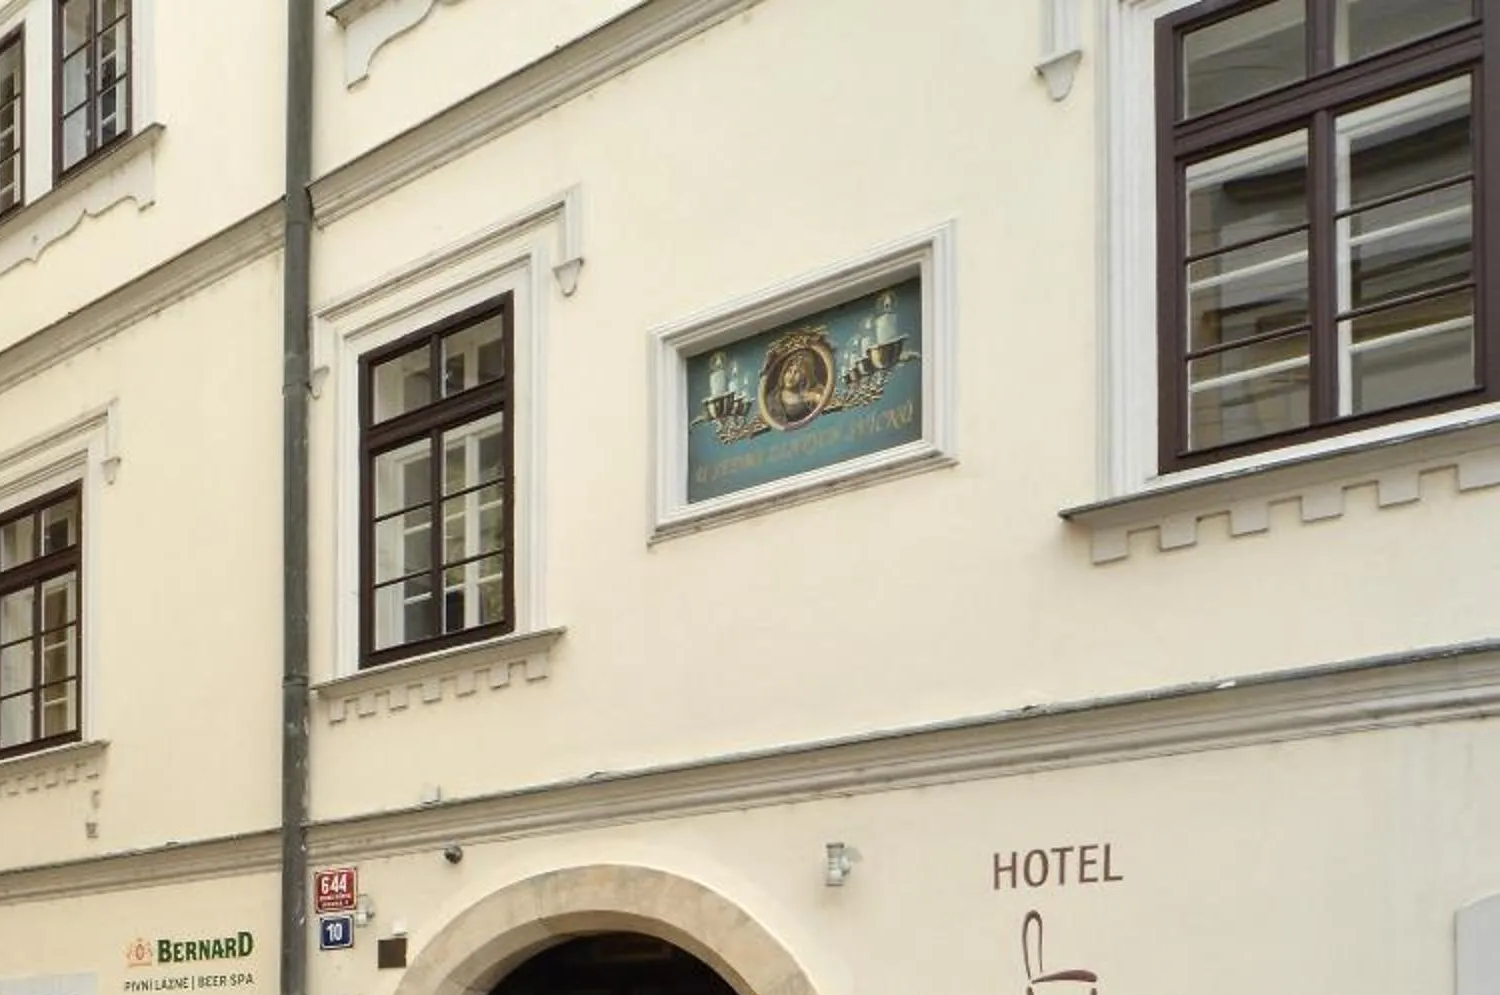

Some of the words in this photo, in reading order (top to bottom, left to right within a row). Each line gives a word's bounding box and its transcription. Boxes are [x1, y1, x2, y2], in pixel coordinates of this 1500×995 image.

[992, 843, 1124, 890] HOTEL
[321, 873, 347, 895] 644
[326, 923, 343, 941] 10
[157, 931, 254, 964] BERNARD
[198, 975, 227, 988] BEER
[230, 972, 254, 986] SPA
